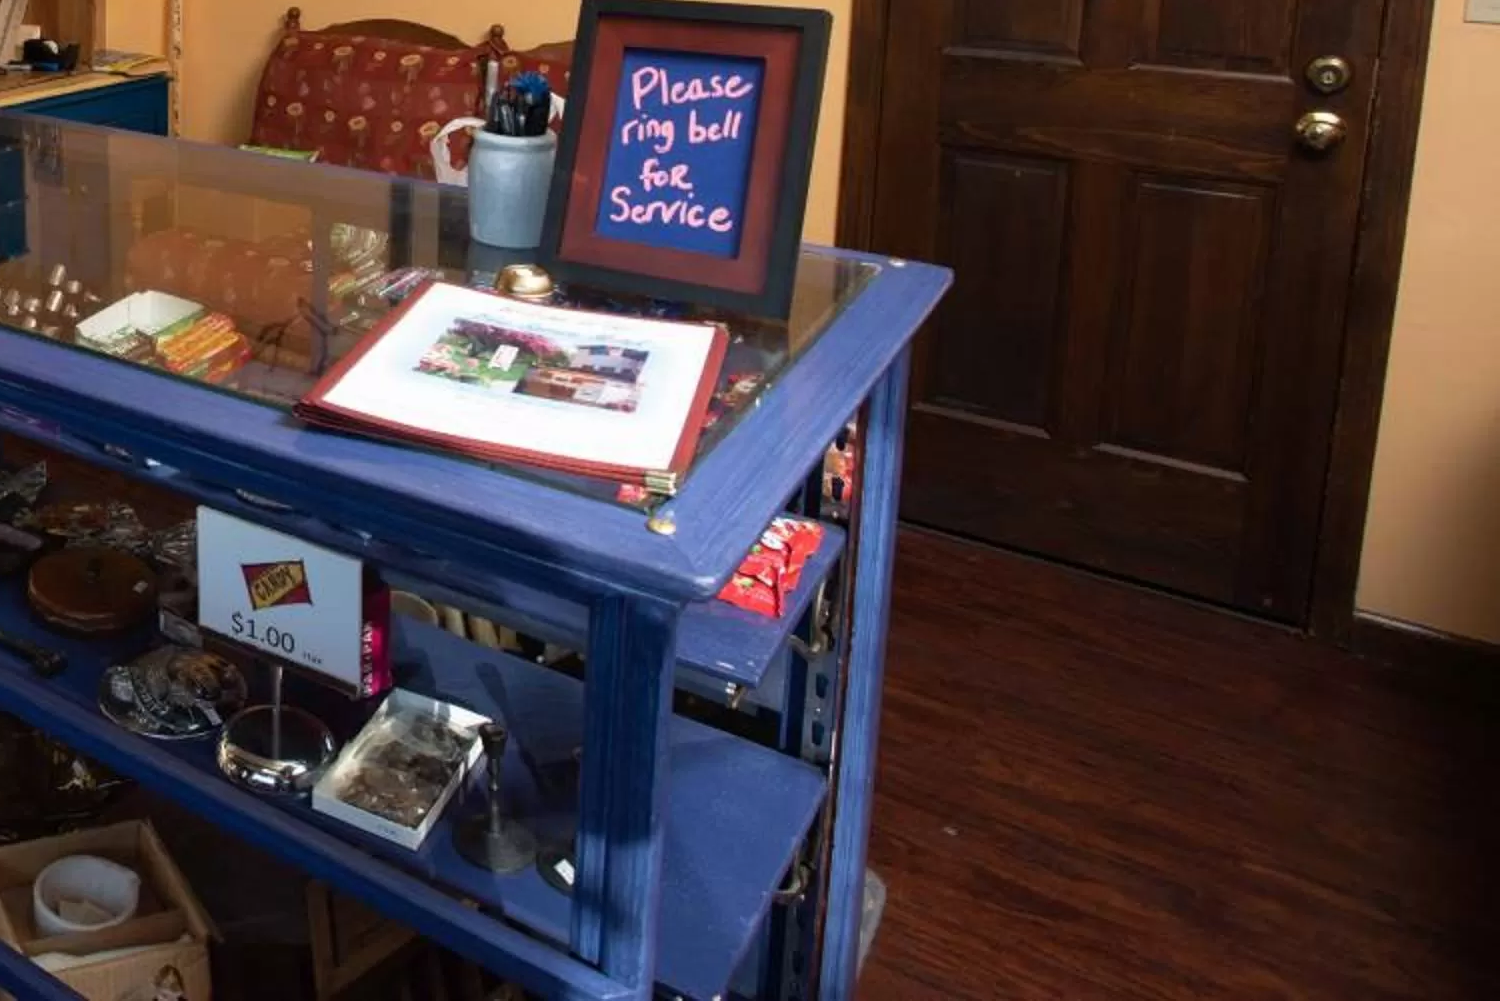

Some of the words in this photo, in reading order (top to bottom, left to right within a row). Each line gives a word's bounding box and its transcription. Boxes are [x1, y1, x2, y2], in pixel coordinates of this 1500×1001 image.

[632, 66, 753, 110] Please
[621, 113, 675, 154] ring
[688, 109, 742, 144] bell
[610, 186, 733, 232] Service
[253, 564, 296, 601] CANDY
[231, 611, 296, 654] $1.00
